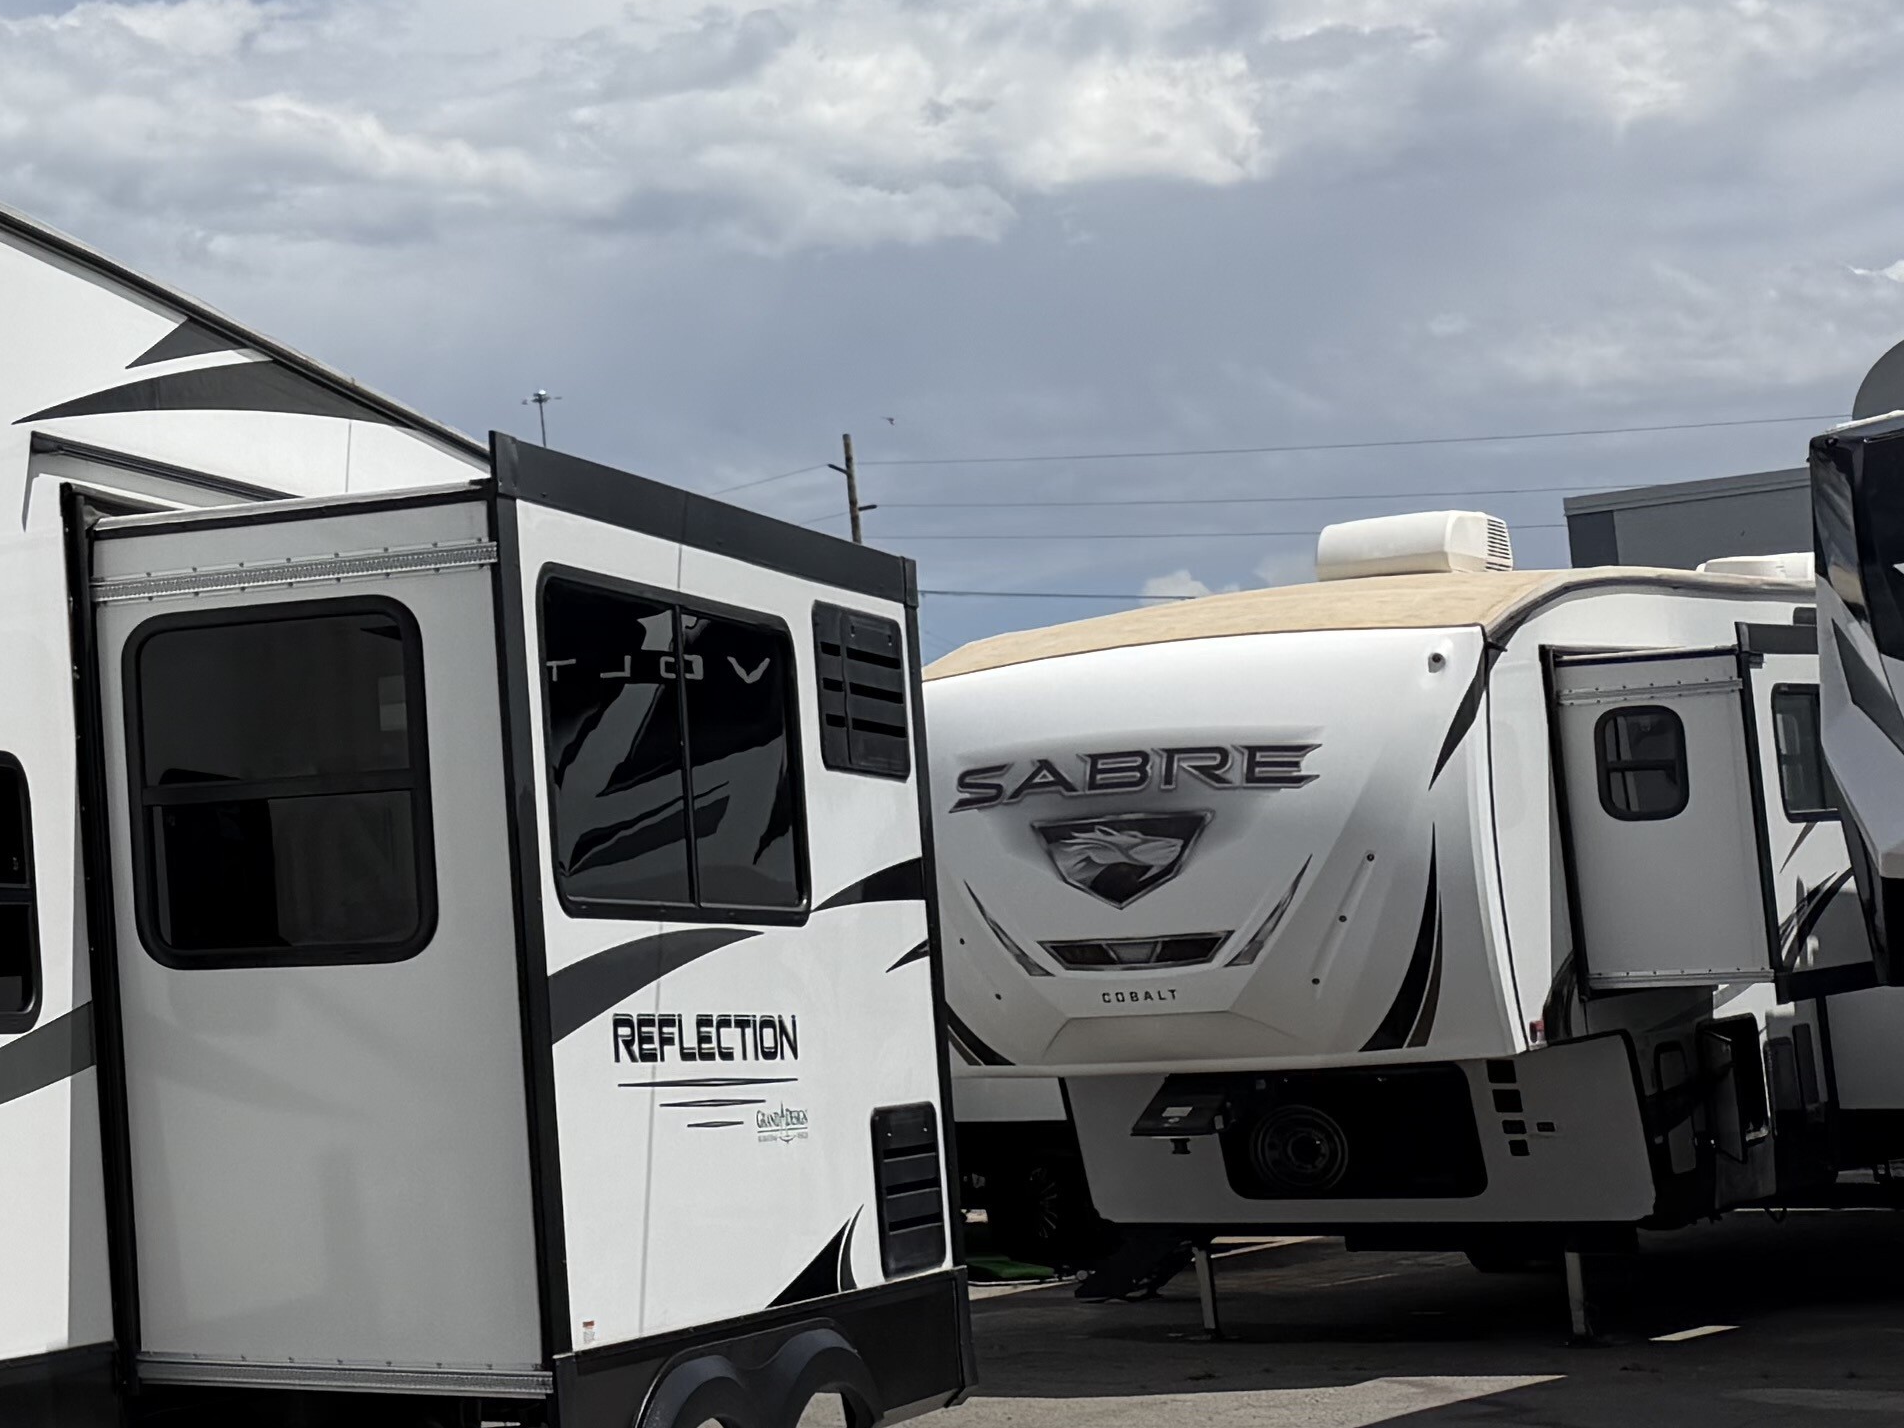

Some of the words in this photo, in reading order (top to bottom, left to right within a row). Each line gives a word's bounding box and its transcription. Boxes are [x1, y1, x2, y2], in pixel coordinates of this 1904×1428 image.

[948, 743, 1323, 814] SABRE
[1102, 988, 1176, 1003] COBALT
[612, 1013, 799, 1063] REFLECTION
